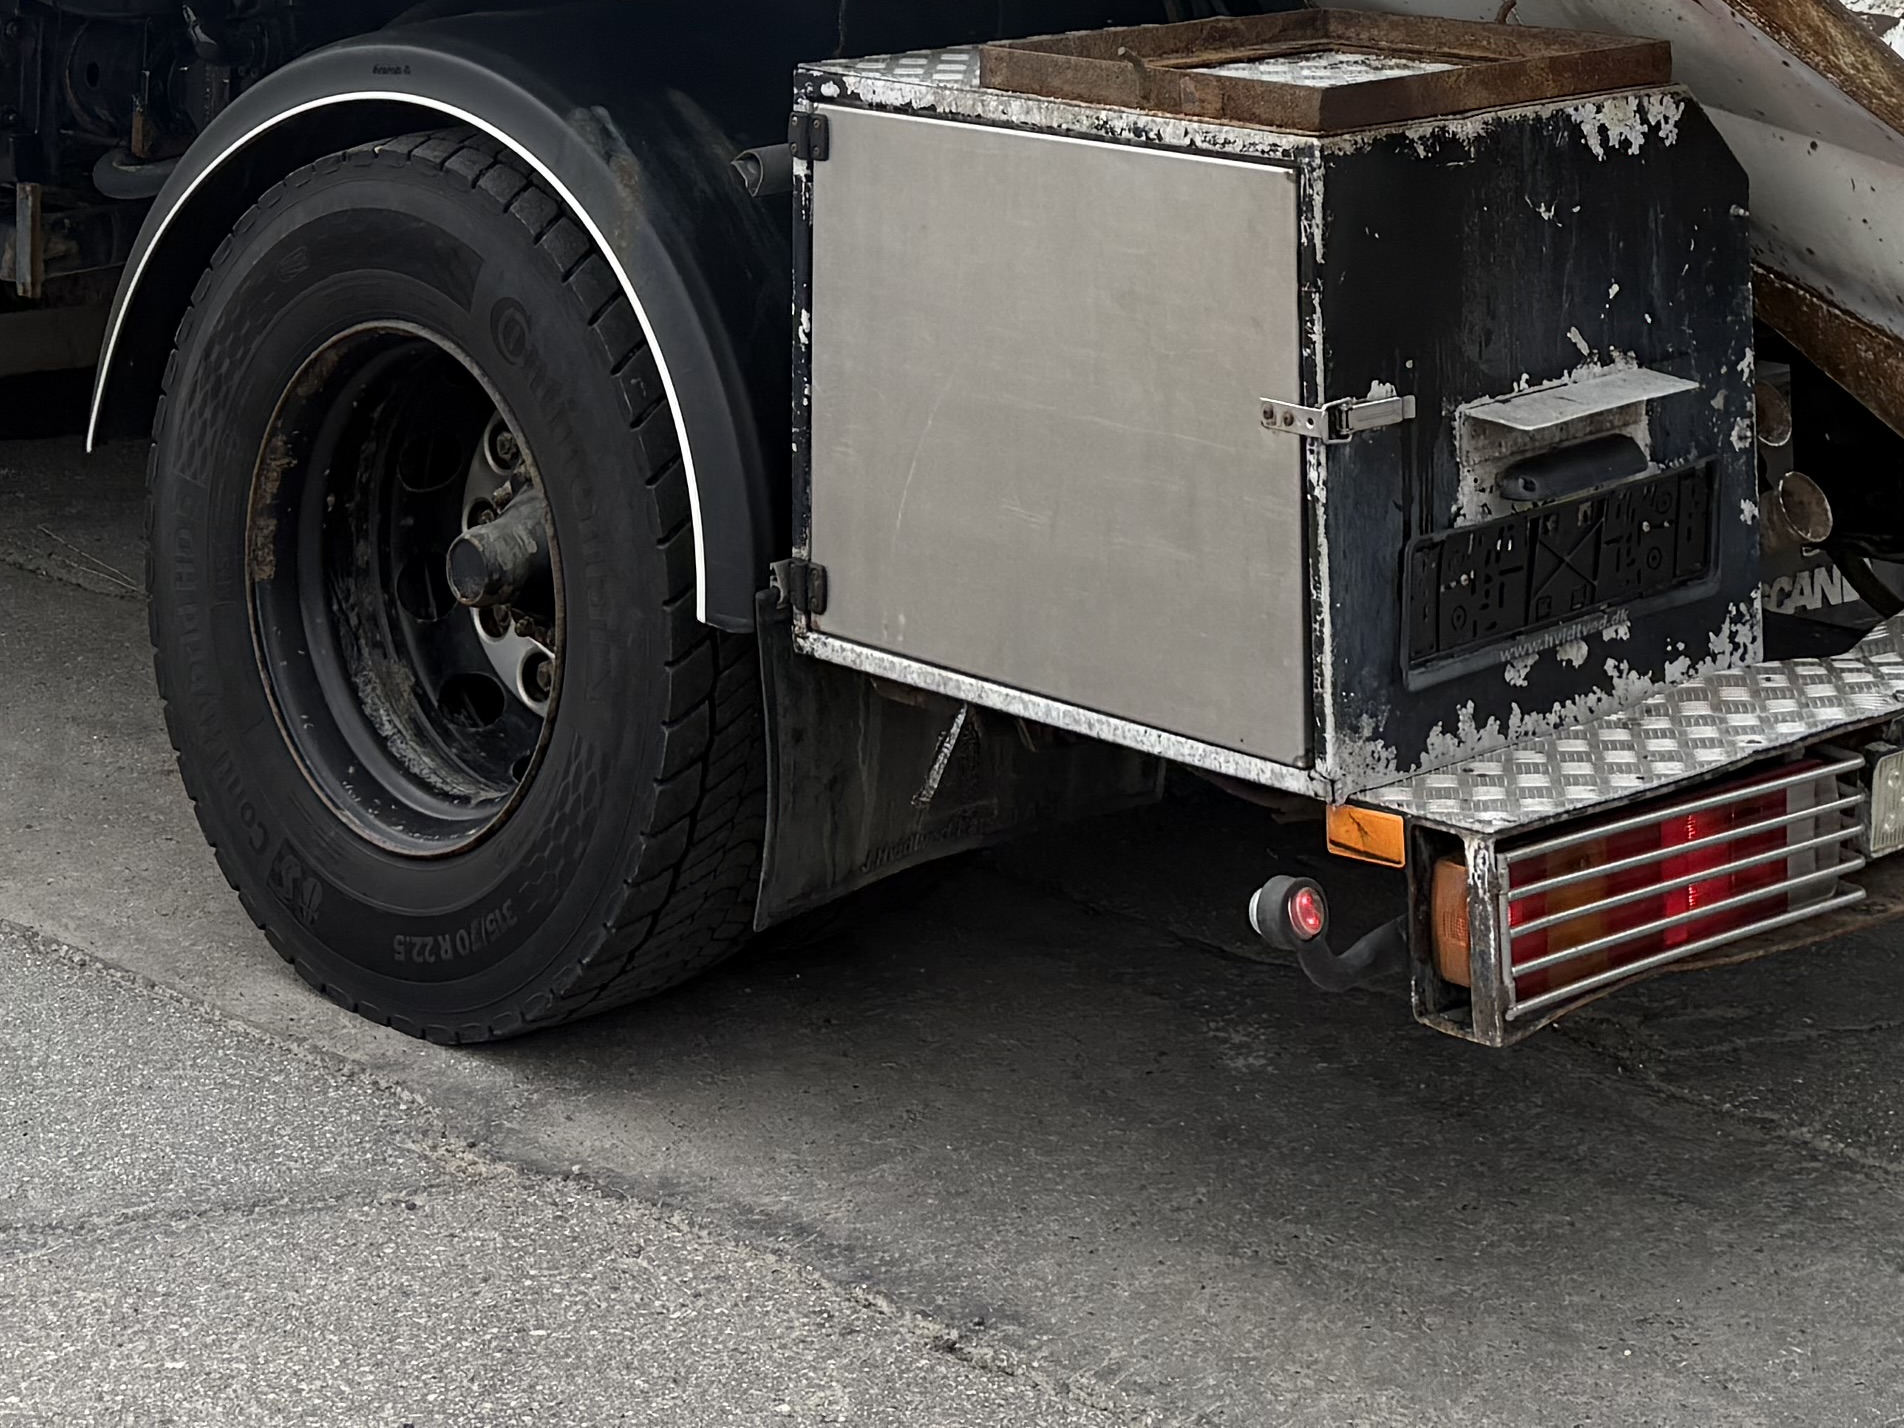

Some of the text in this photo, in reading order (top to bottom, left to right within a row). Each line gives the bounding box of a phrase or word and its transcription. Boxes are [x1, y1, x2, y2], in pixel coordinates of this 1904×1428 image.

[392, 897, 519, 964] 315/70 R 22.5
